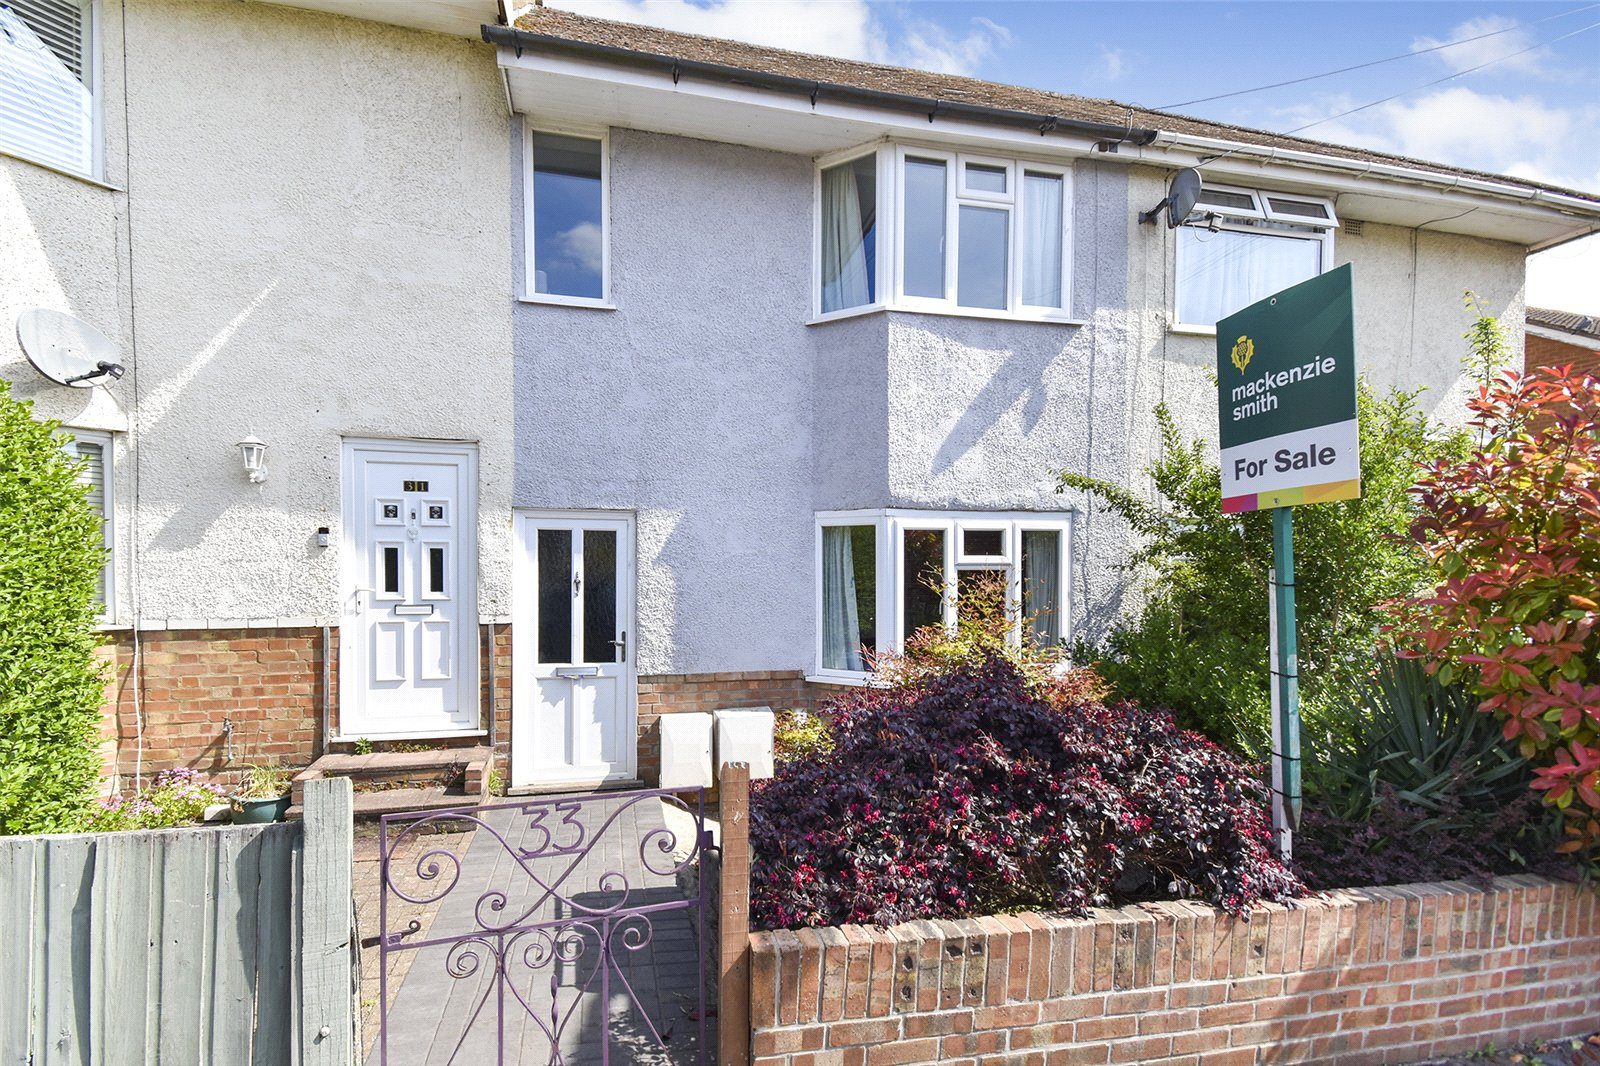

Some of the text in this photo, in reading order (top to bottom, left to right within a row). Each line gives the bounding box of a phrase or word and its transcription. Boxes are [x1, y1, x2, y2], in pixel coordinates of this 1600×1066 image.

[1232, 356, 1336, 402] mackenzie
[1232, 393, 1278, 422] smith
[1234, 443, 1336, 481] For Sale
[406, 482, 426, 491] 31
[519, 803, 585, 855] 33
